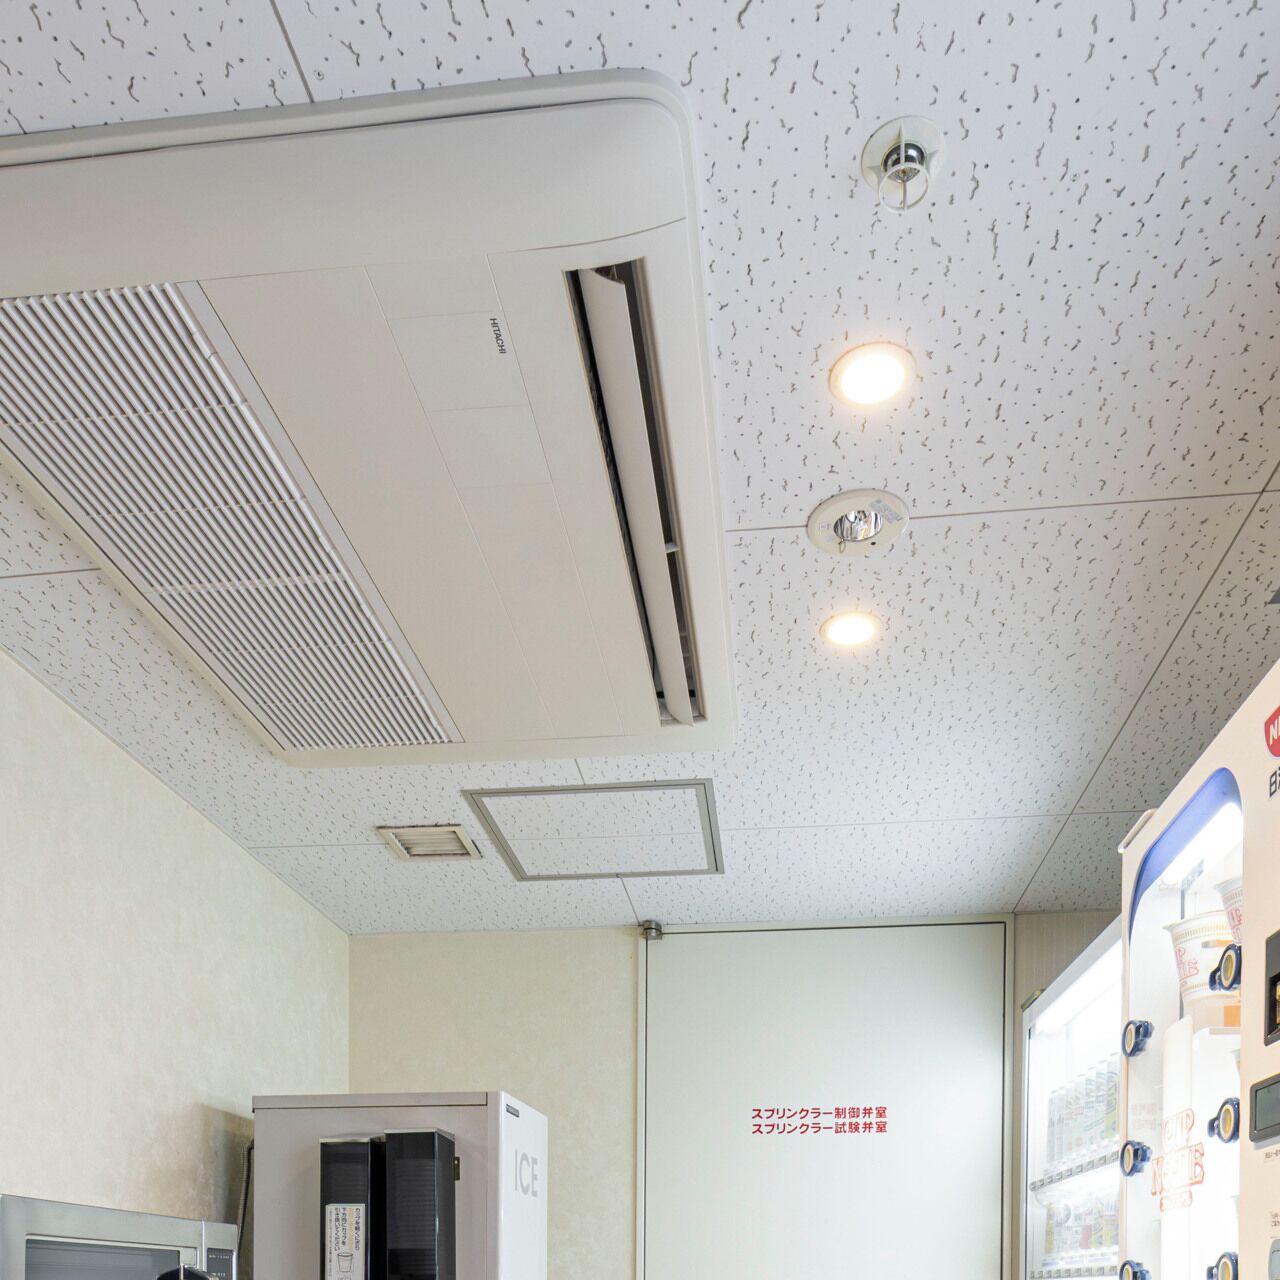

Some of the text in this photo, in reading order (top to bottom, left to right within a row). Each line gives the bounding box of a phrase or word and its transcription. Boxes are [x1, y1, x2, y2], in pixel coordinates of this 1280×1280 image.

[489, 317, 507, 354] HITACHI
[751, 1106, 888, 1120] スプリンクラー制御弁室
[751, 1121, 889, 1135] スプリンクラー試験弁室
[514, 1148, 539, 1198] ICE
